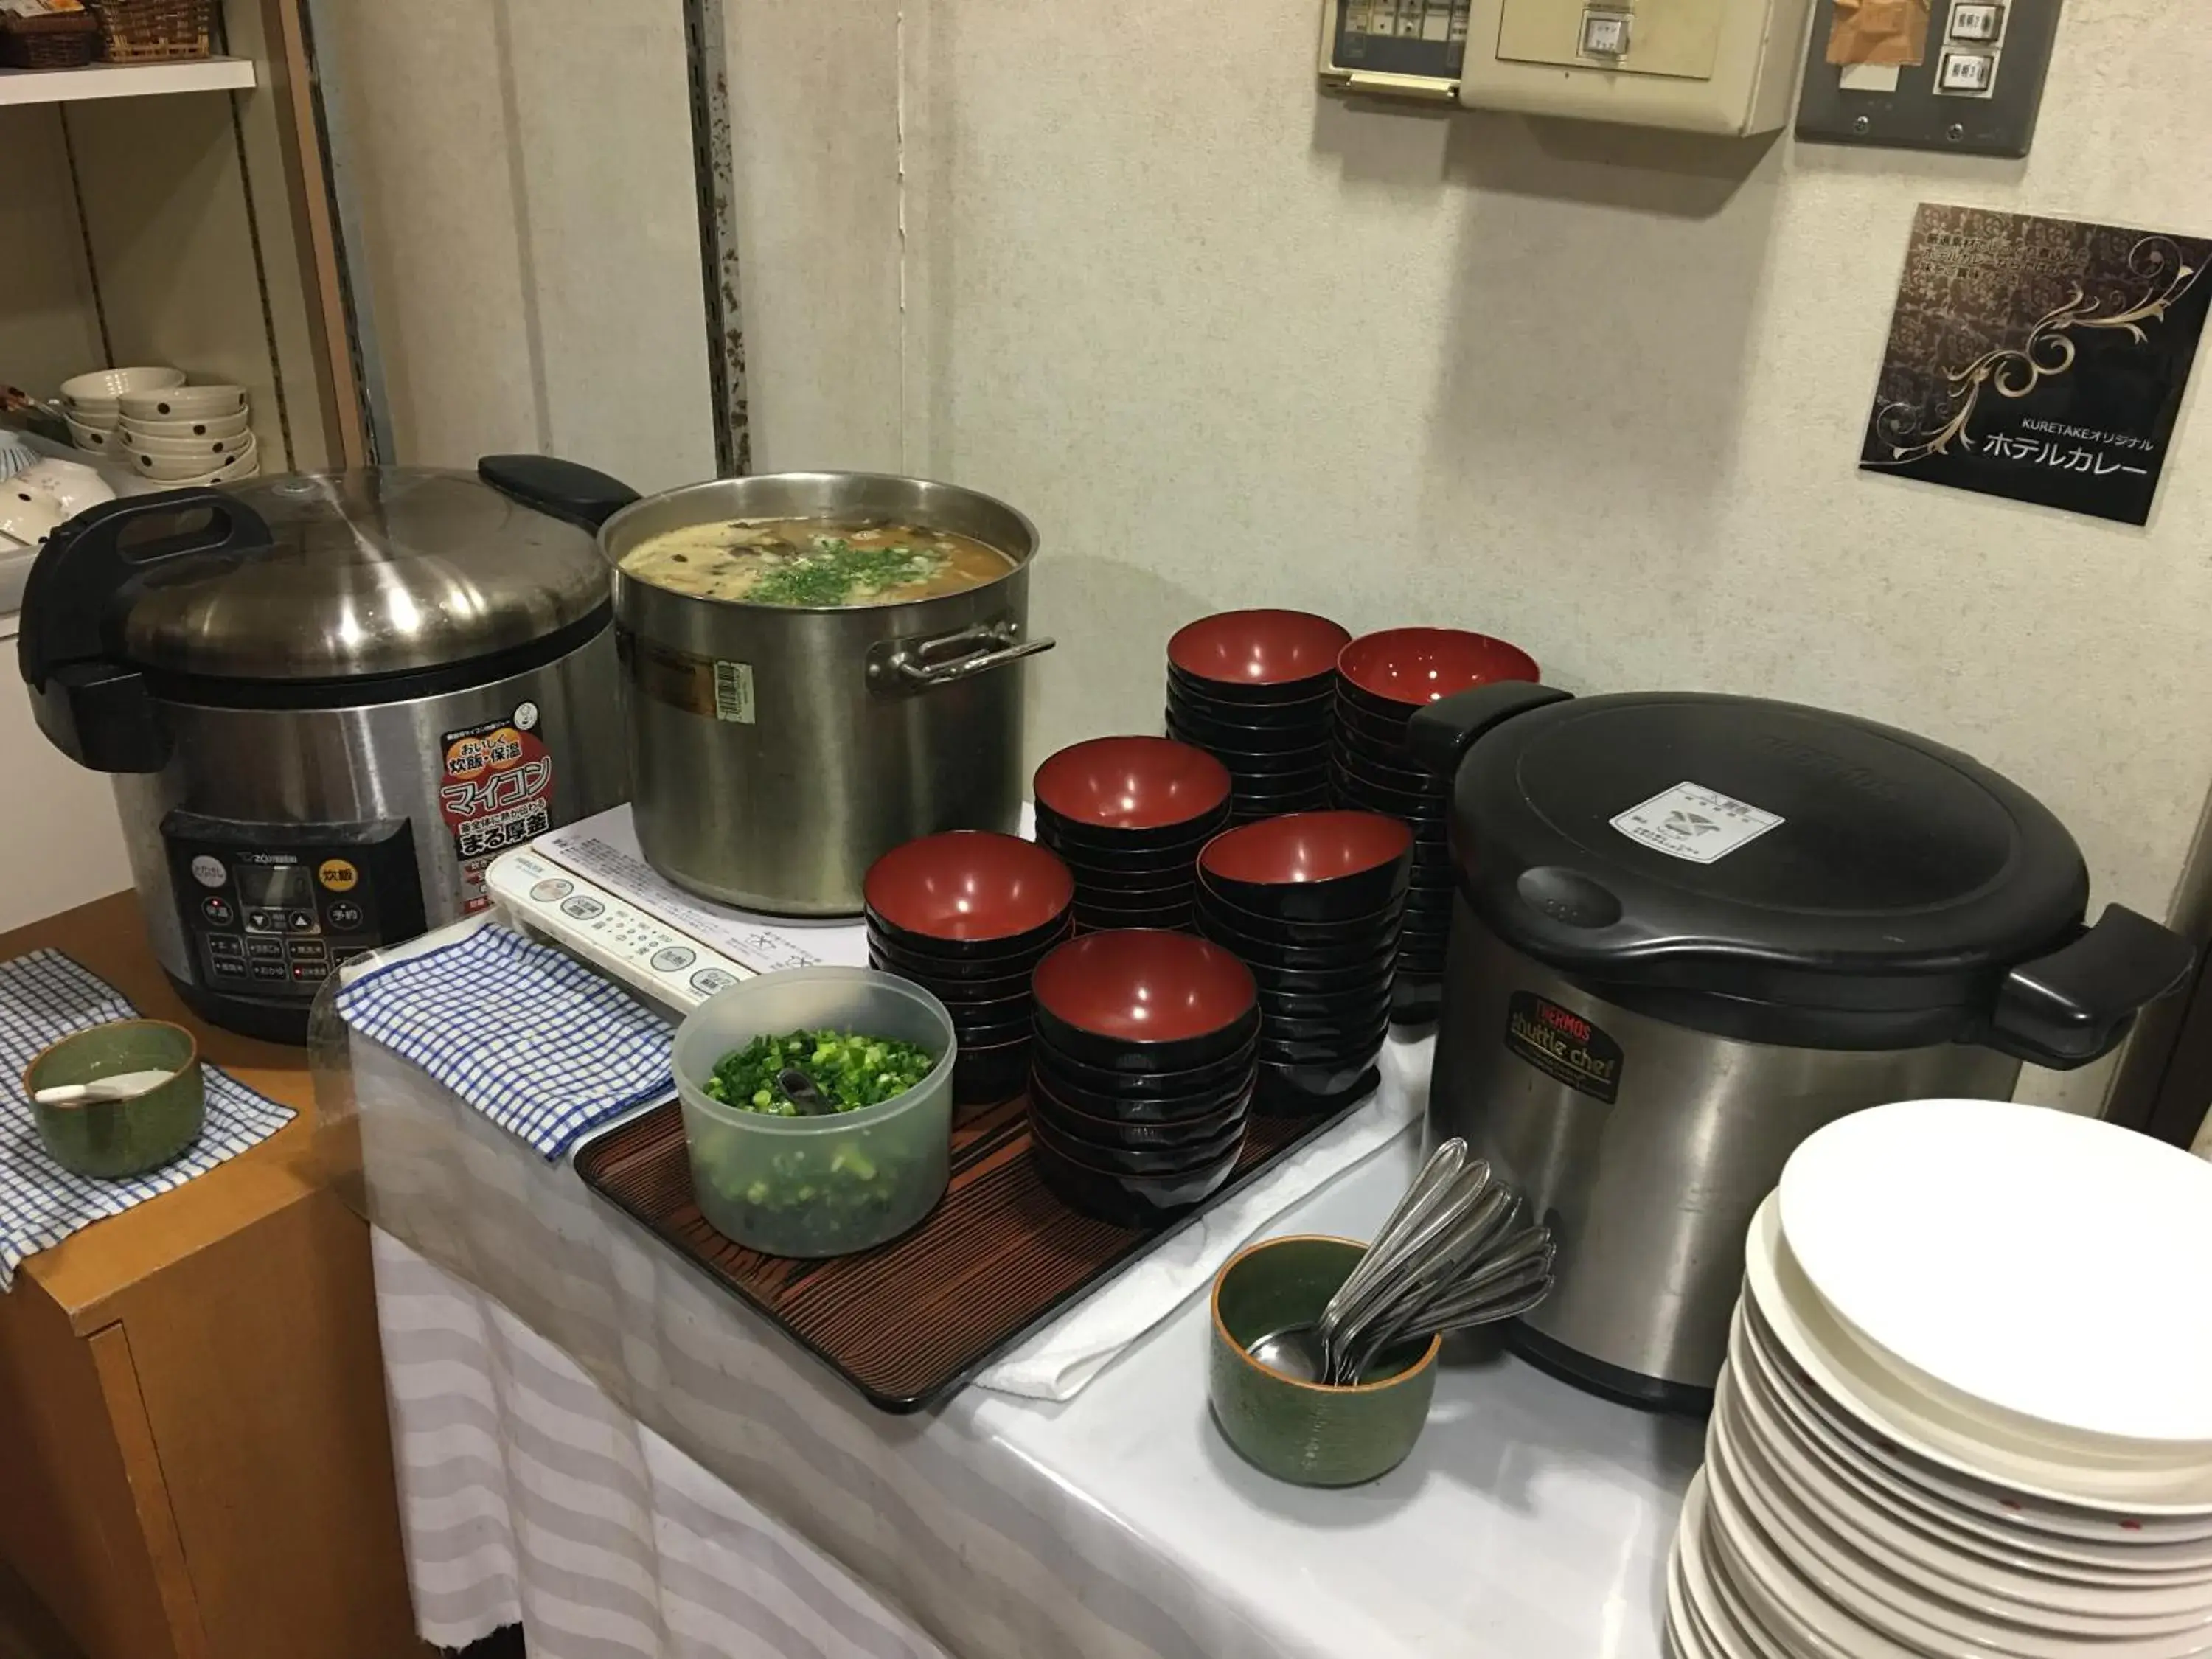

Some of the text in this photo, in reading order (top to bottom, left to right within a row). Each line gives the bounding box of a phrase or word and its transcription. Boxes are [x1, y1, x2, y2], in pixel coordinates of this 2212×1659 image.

[2022, 417, 2154, 451] KURETAKEオリジナル
[1983, 432, 2148, 475] ホテルカレー
[448, 741, 521, 774] 炊飯・保温
[461, 734, 506, 756] おいしく
[441, 755, 552, 817] マイコン
[462, 811, 548, 855] まる厚釜
